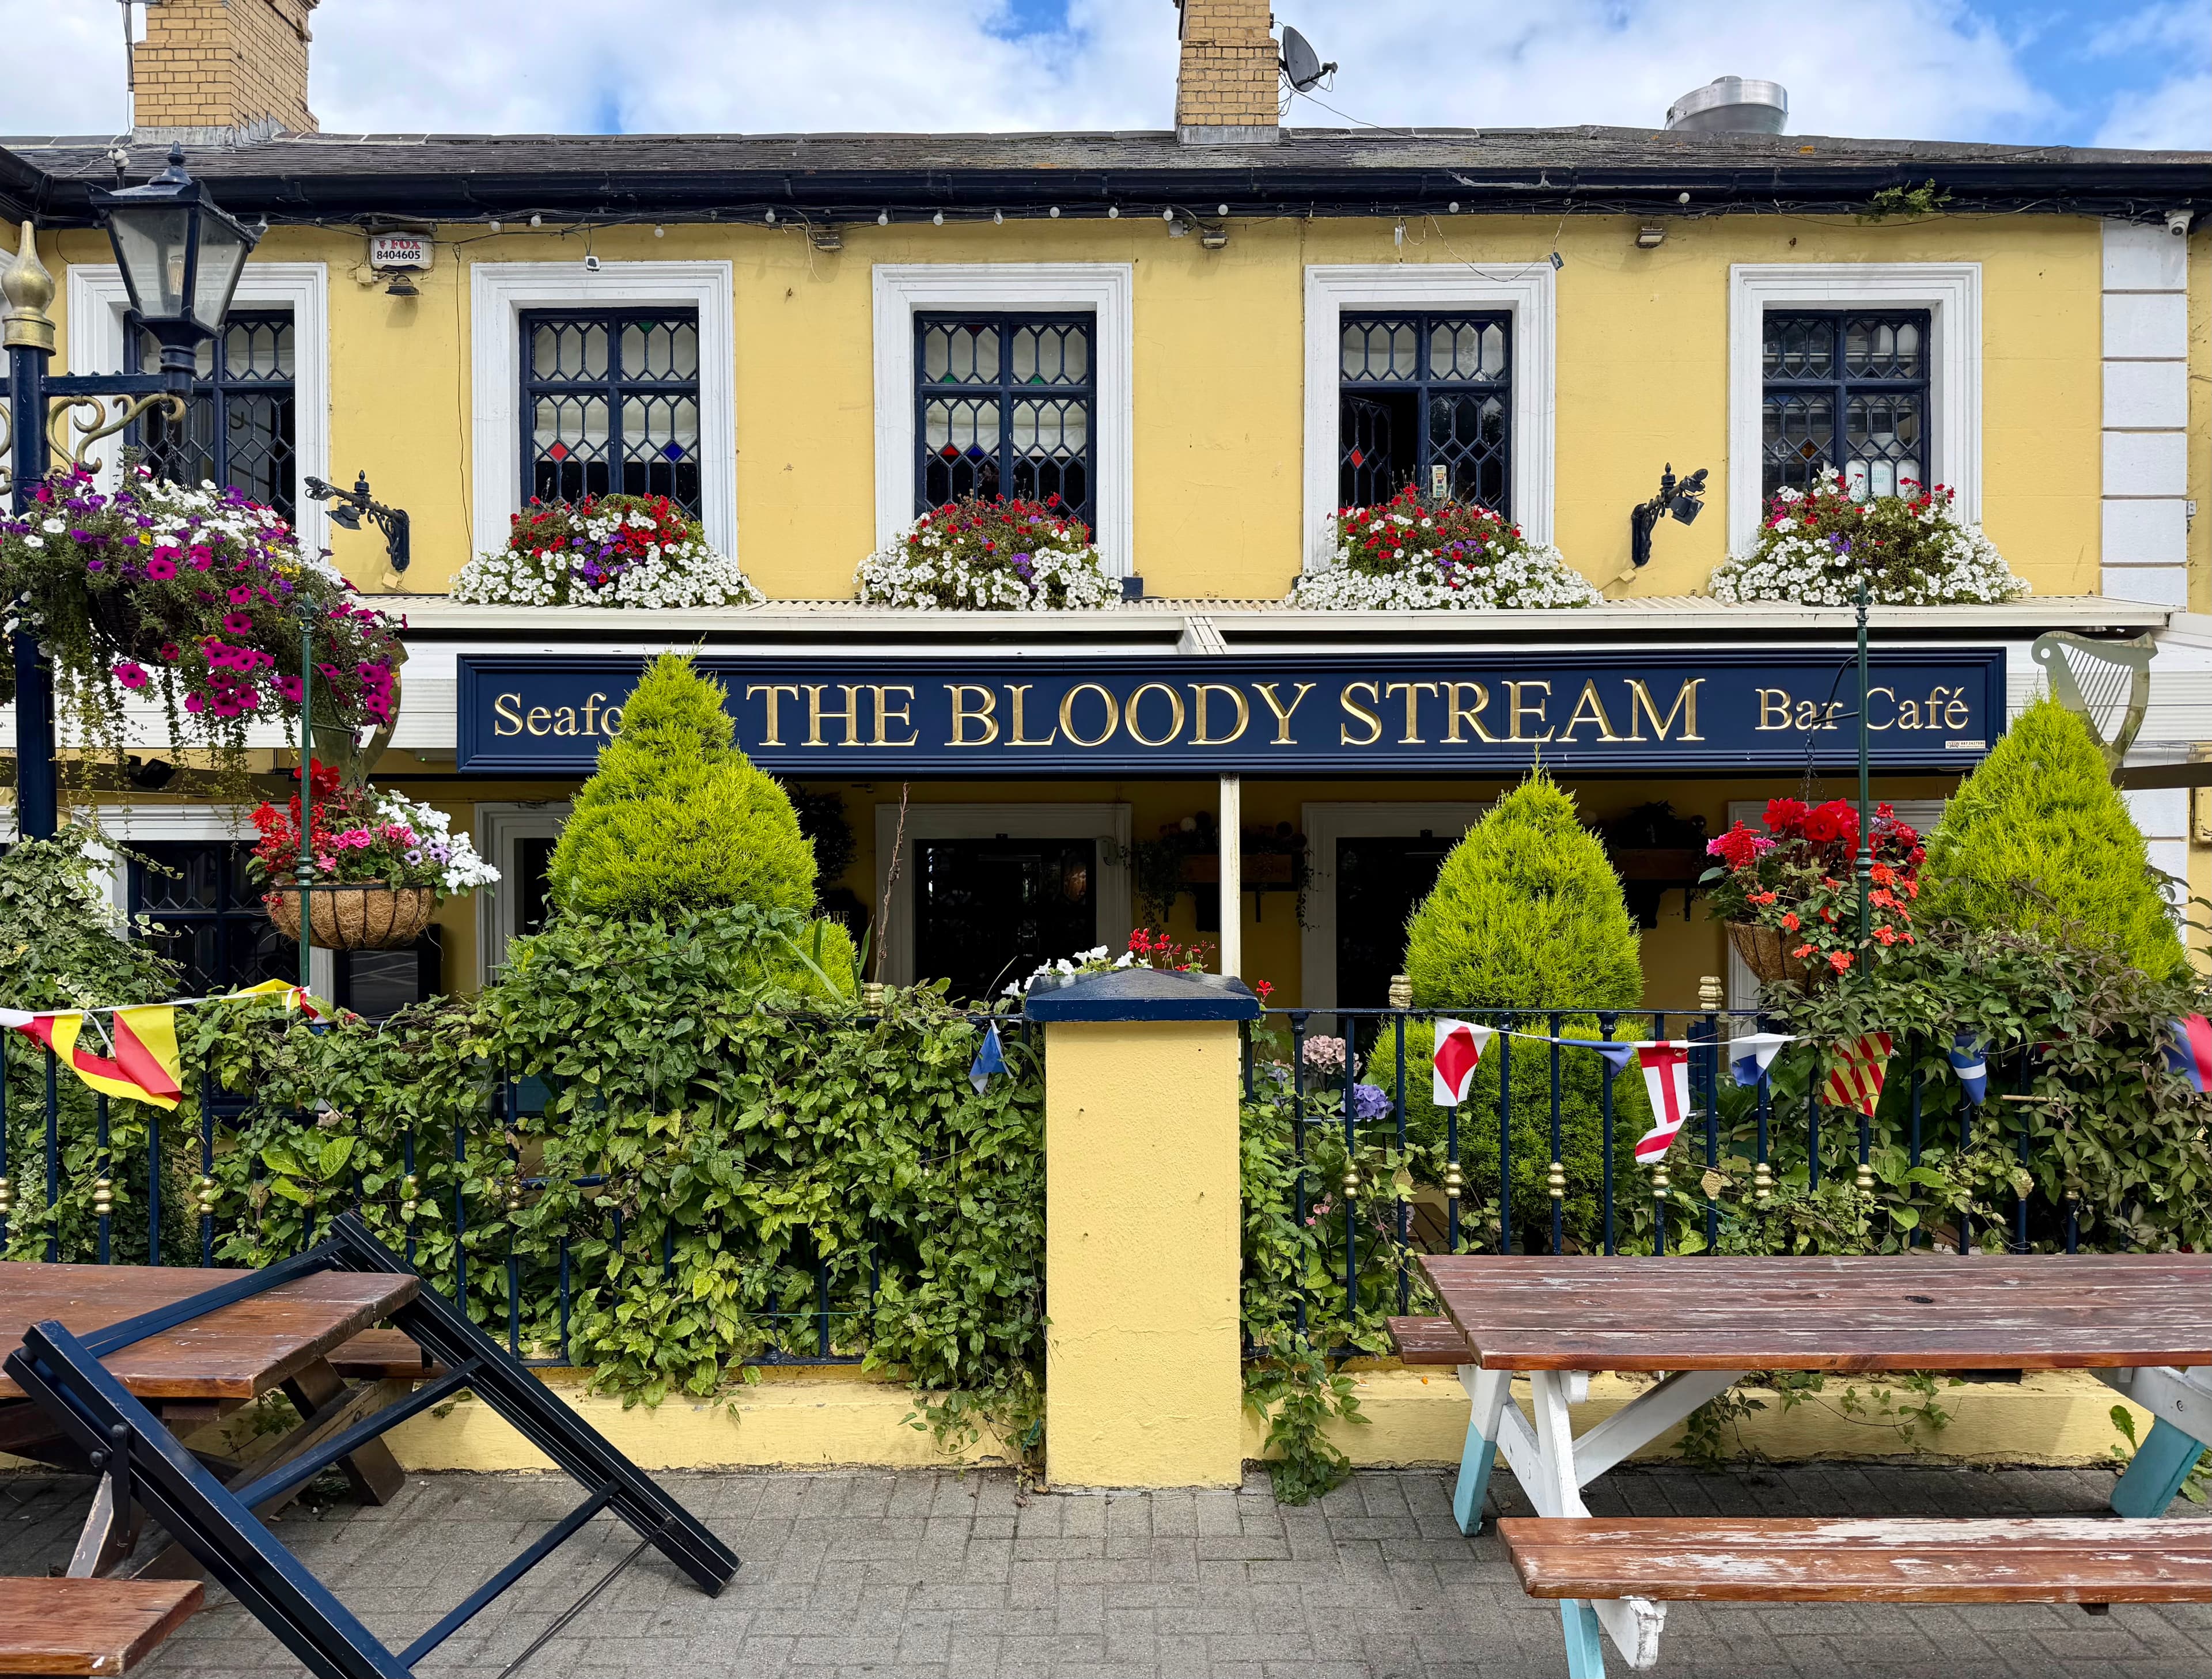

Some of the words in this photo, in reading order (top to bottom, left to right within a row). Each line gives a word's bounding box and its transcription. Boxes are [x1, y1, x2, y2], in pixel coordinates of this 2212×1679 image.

[391, 240, 421, 249] FOX
[377, 251, 421, 260] 8404605
[494, 692, 626, 736] Seafo
[746, 683, 919, 746] THE
[943, 682, 1316, 747] BLOODY
[1340, 678, 1706, 746] STREAM
[1755, 688, 1843, 730] Bar
[1867, 687, 1969, 730] Café
[815, 908, 850, 922] FRE
